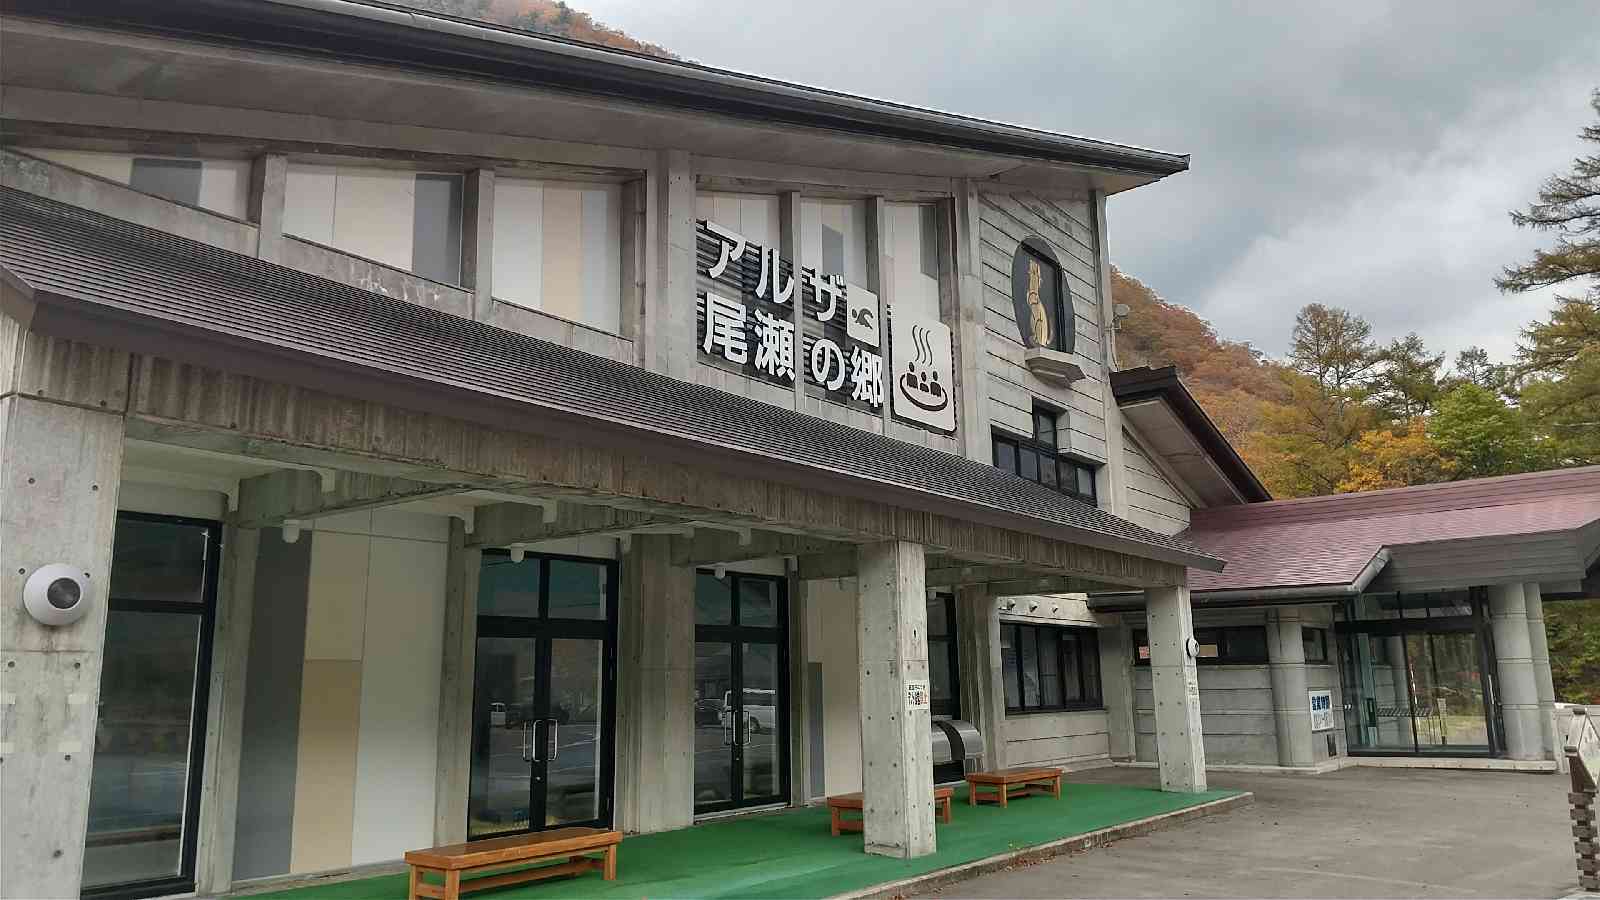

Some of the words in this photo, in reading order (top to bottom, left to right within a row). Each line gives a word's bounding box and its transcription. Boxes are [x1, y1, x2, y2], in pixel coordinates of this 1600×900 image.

[706, 220, 847, 322] アルザ
[703, 291, 884, 408] 尾瀬の郷
